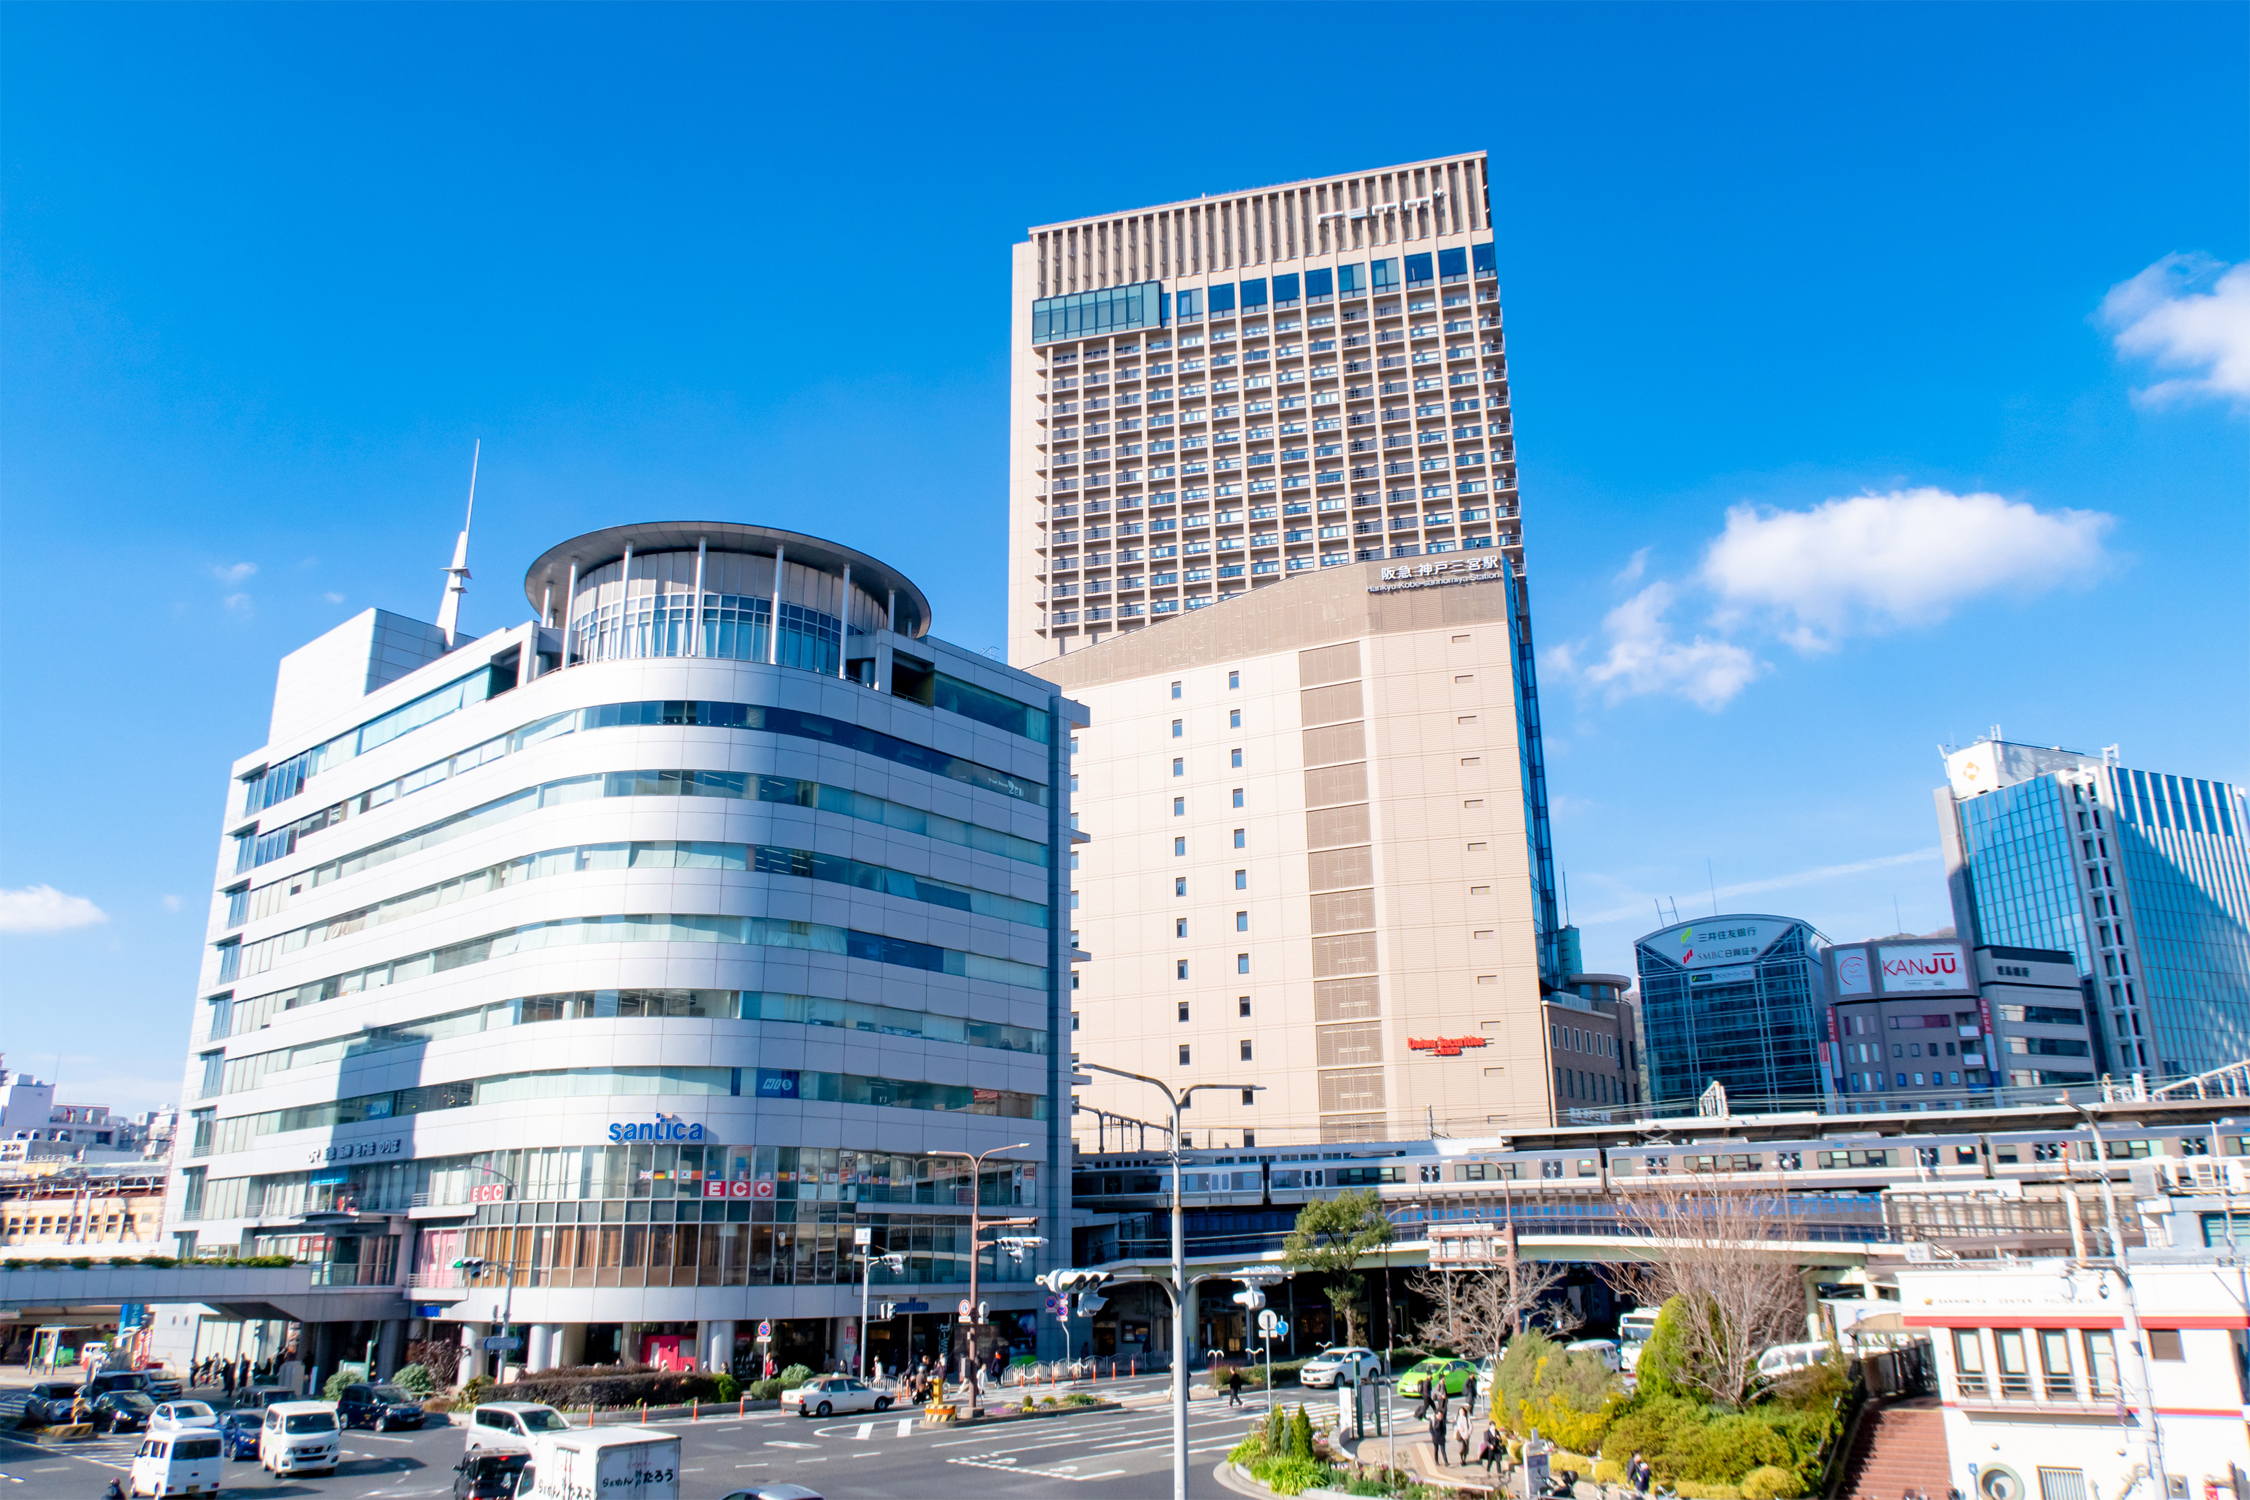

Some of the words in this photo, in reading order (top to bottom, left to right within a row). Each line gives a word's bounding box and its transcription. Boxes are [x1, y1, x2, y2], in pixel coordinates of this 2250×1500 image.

[1380, 566, 1412, 581] 阪急
[1418, 555, 1499, 577] 神戸三宮駅
[1365, 583, 1396, 593] Hankyu
[1469, 572, 1500, 582] Station
[1698, 927, 1757, 943] 三井住友銀行
[1697, 946, 1758, 961] SMBC日興証券
[1437, 1035, 1485, 1049] Securities
[762, 1078, 793, 1091] HIS
[608, 1113, 704, 1141] santica
[472, 1185, 503, 1202] ECC
[708, 1181, 771, 1197] ECC
